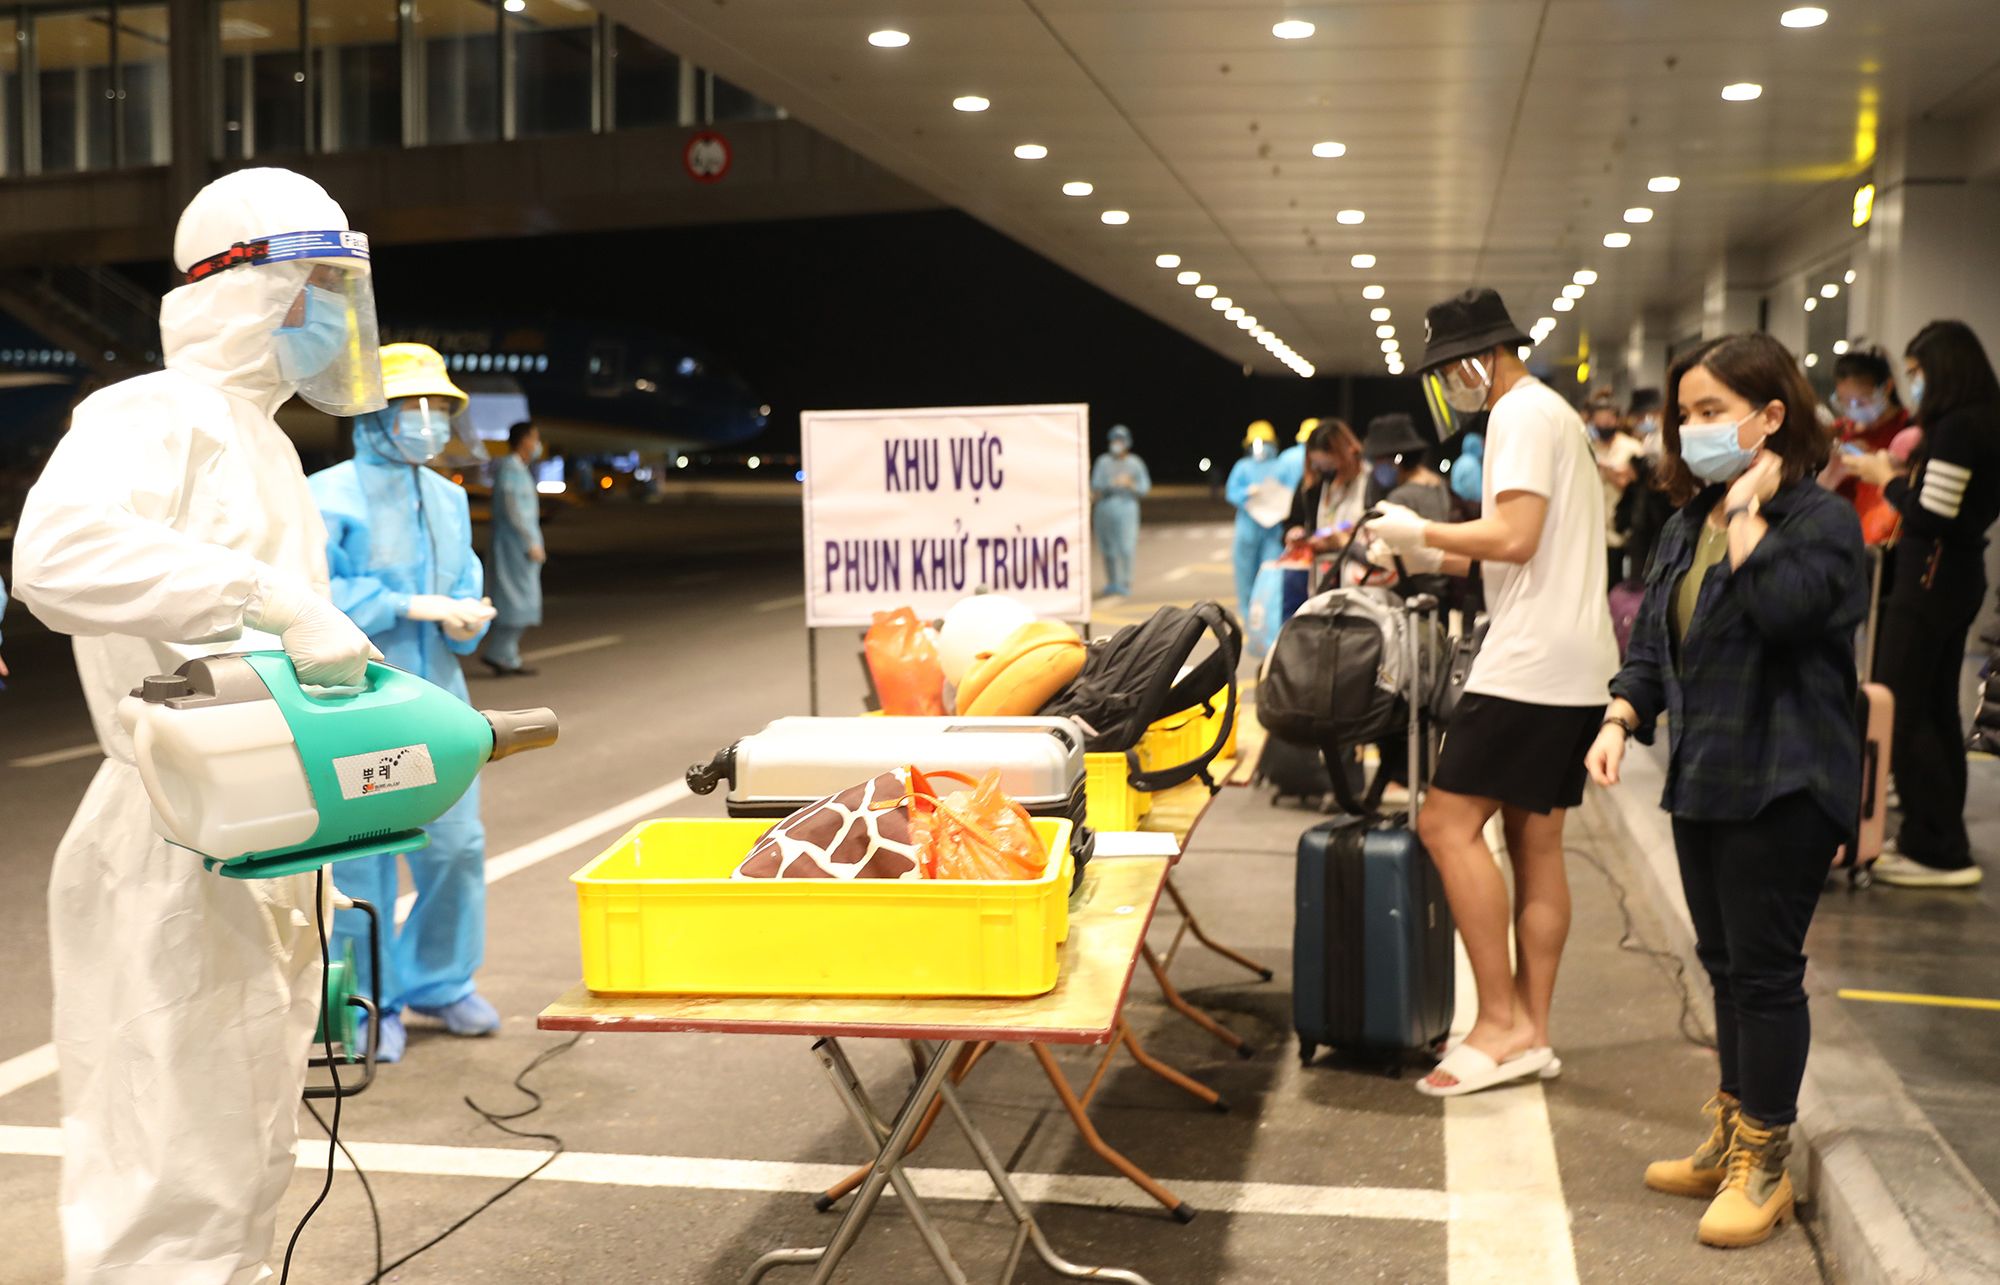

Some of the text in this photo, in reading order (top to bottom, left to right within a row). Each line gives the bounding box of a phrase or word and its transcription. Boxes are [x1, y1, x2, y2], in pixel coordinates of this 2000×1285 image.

[885, 431, 1004, 504] KHU VỰC
[824, 518, 1070, 593] PHUN KHỬ TRÙNG
